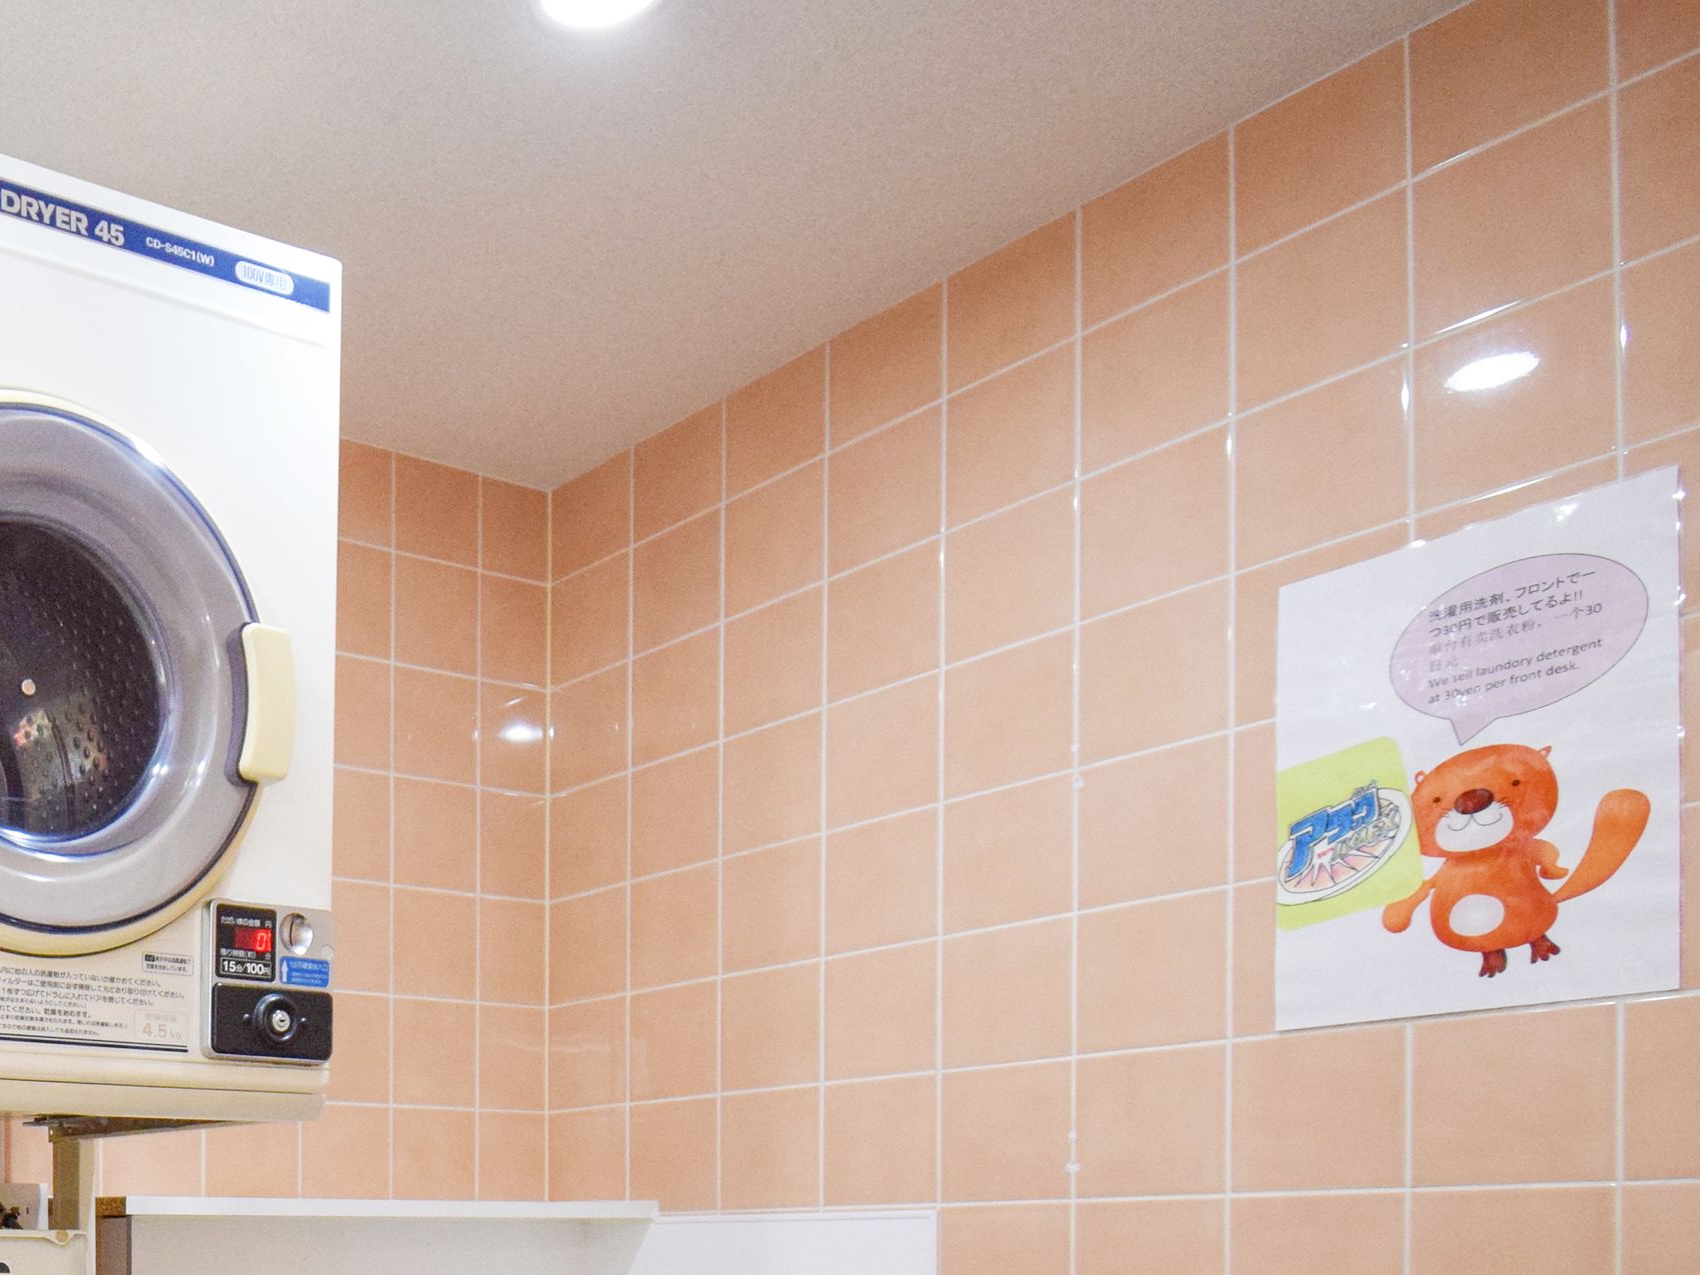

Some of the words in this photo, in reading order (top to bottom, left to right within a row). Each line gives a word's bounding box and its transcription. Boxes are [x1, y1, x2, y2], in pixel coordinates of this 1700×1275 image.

[0, 188, 89, 237] DRYER
[94, 218, 125, 247] 45
[1536, 637, 1604, 662] detergent
